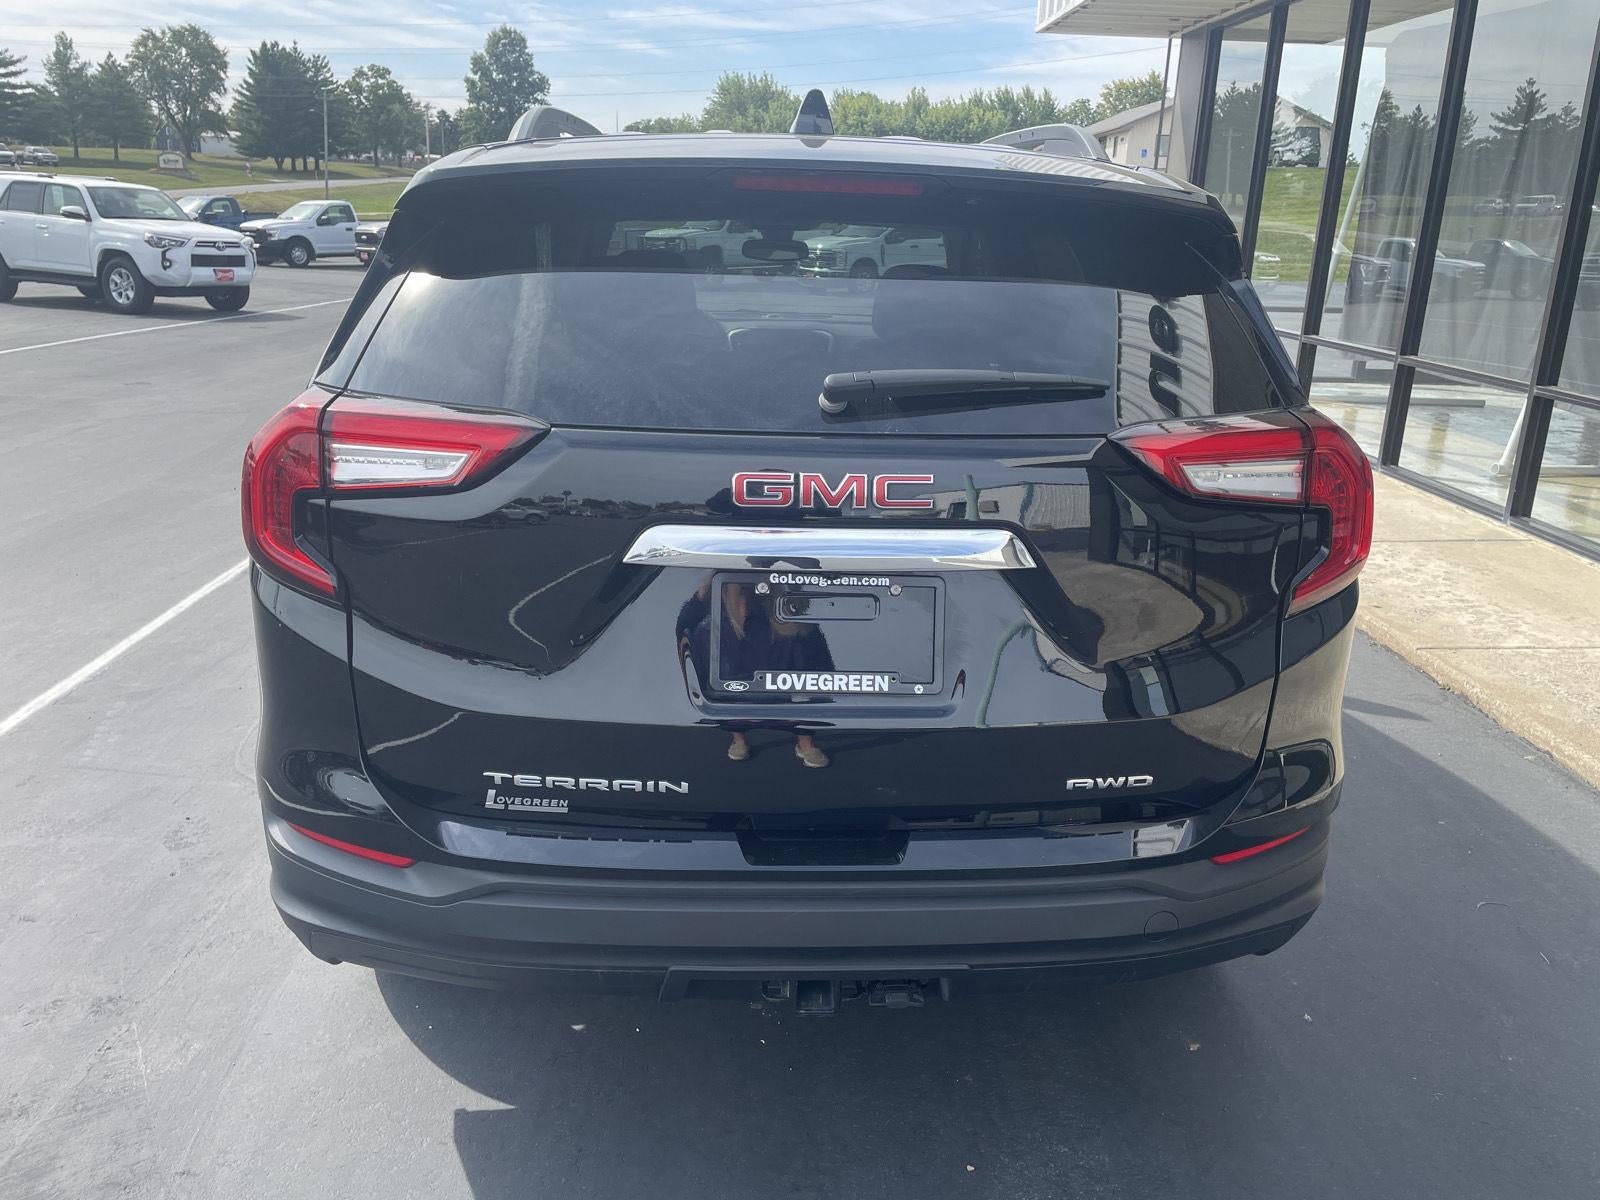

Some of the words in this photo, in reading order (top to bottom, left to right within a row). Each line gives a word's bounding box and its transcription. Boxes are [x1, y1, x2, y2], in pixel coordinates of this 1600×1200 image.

[732, 471, 934, 508] GMC
[765, 673, 888, 691] LOVEGREEN
[483, 771, 689, 793] TERRAIN
[1066, 775, 1154, 790] AWD
